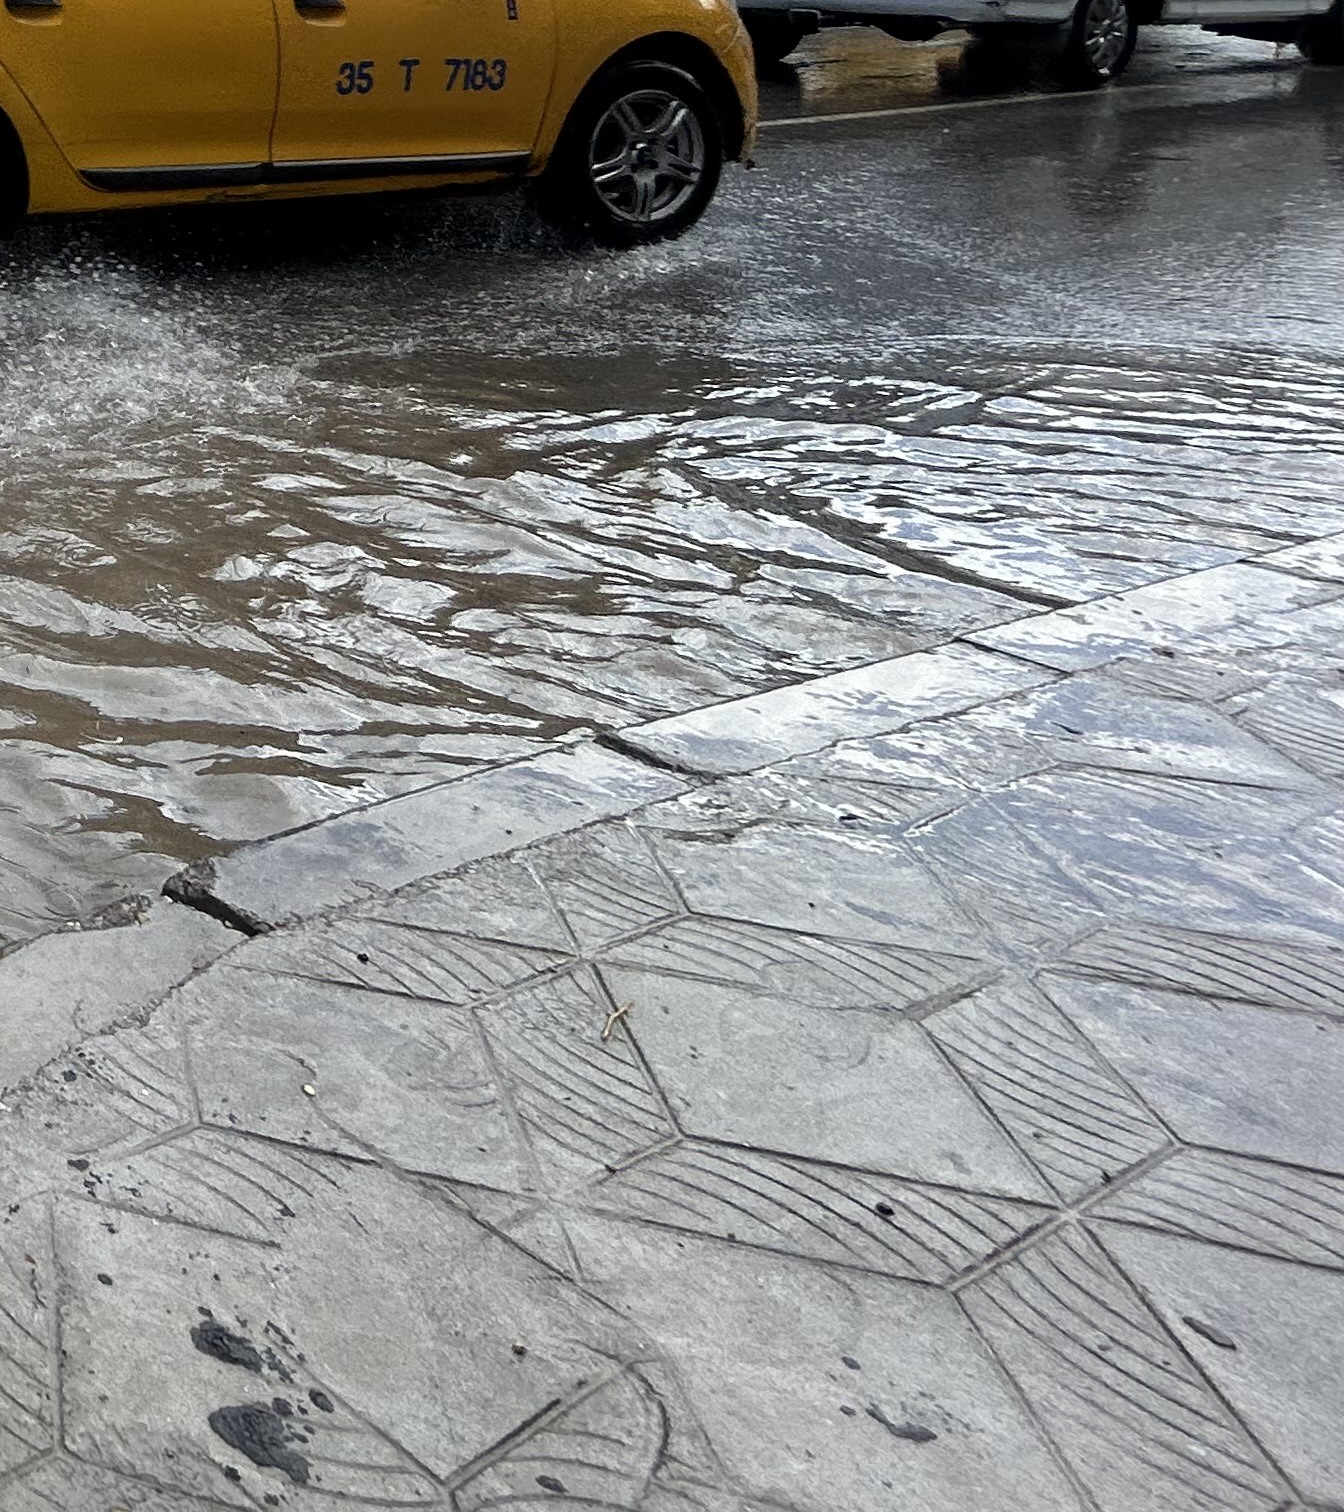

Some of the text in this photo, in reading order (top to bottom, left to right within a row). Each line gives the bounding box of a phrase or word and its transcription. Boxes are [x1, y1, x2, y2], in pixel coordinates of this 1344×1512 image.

[336, 58, 508, 96] 35 T 7183
